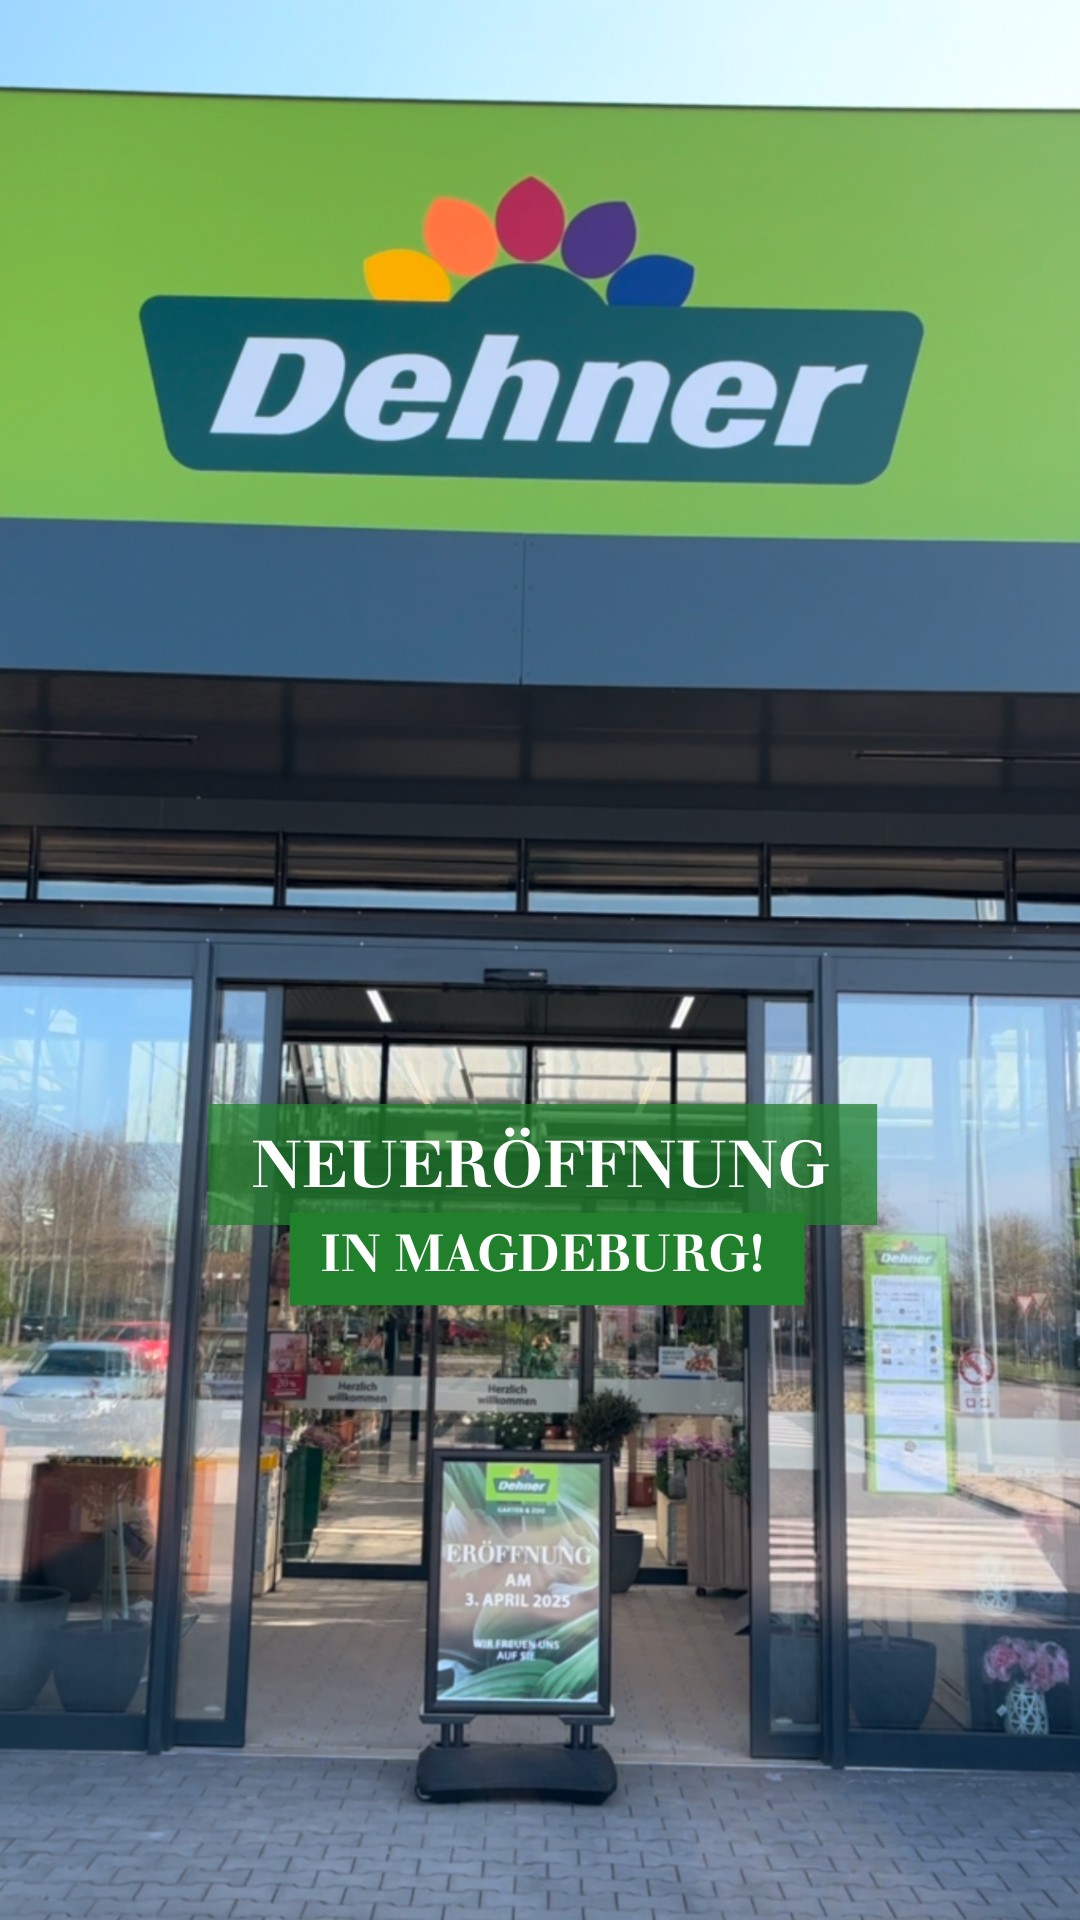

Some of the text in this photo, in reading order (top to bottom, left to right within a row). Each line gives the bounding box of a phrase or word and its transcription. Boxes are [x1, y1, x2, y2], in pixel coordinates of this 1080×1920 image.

[209, 334, 868, 449] Dehner
[880, 1252, 932, 1265] Dehner
[338, 1381, 378, 1392] Herzlich
[488, 1383, 527, 1395] Herzlich
[327, 1392, 387, 1404] willkommen
[478, 1394, 537, 1407] willkommen
[497, 1480, 546, 1492] Dehner
[446, 1540, 592, 1566] ERÖFFNUNG
[505, 1573, 531, 1587] AM
[465, 1592, 571, 1609] 3. APRIL 2025
[473, 1638, 560, 1650] WIR FREUEN UNS
[496, 1650, 535, 1661] AUF SIE
